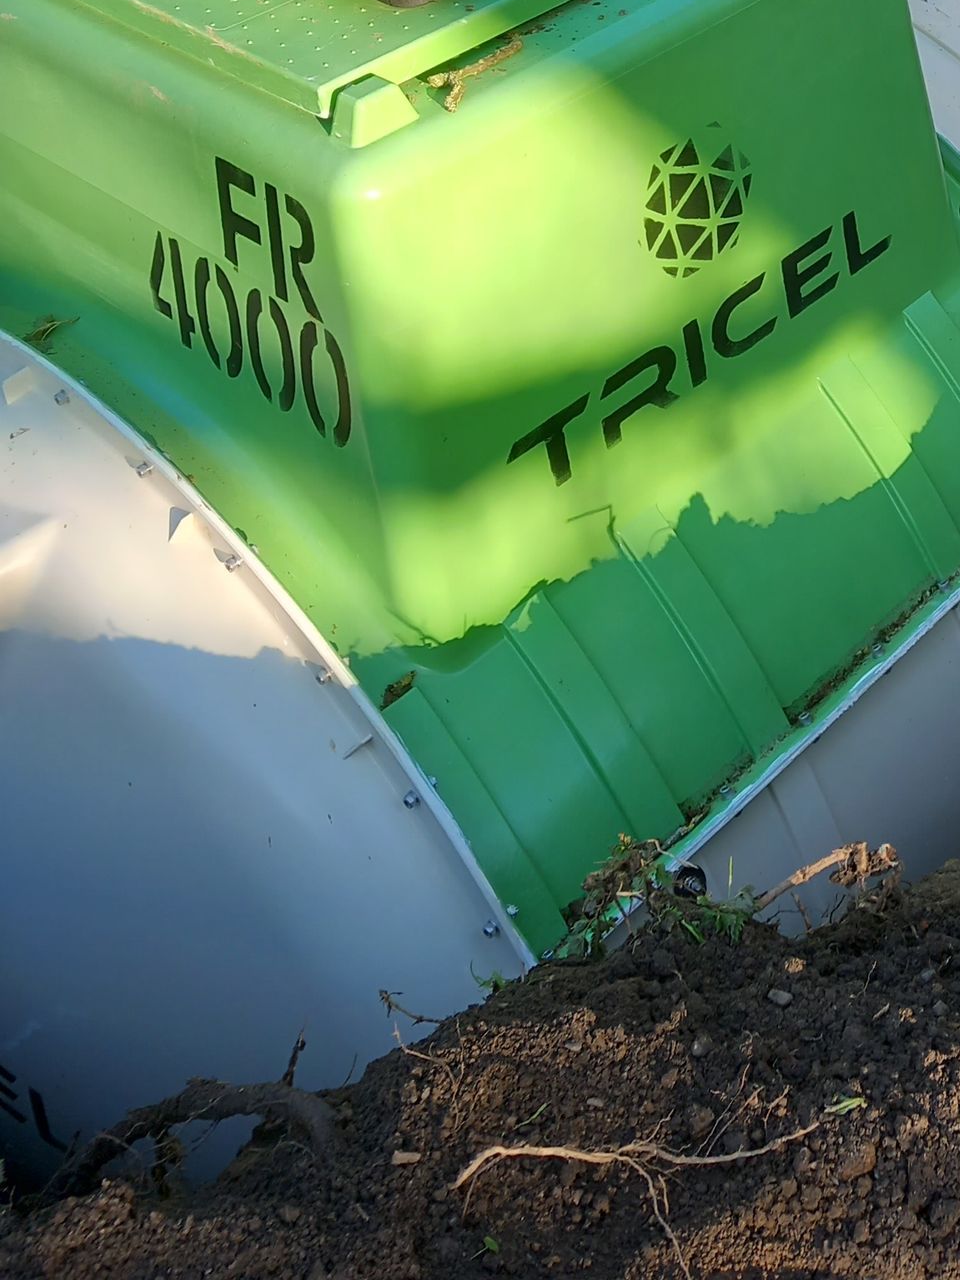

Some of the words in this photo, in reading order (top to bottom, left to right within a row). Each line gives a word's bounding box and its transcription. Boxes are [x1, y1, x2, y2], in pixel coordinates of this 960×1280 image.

[149, 230, 350, 449] 4000
[215, 156, 323, 324] FR
[506, 210, 893, 487] TRICEL
